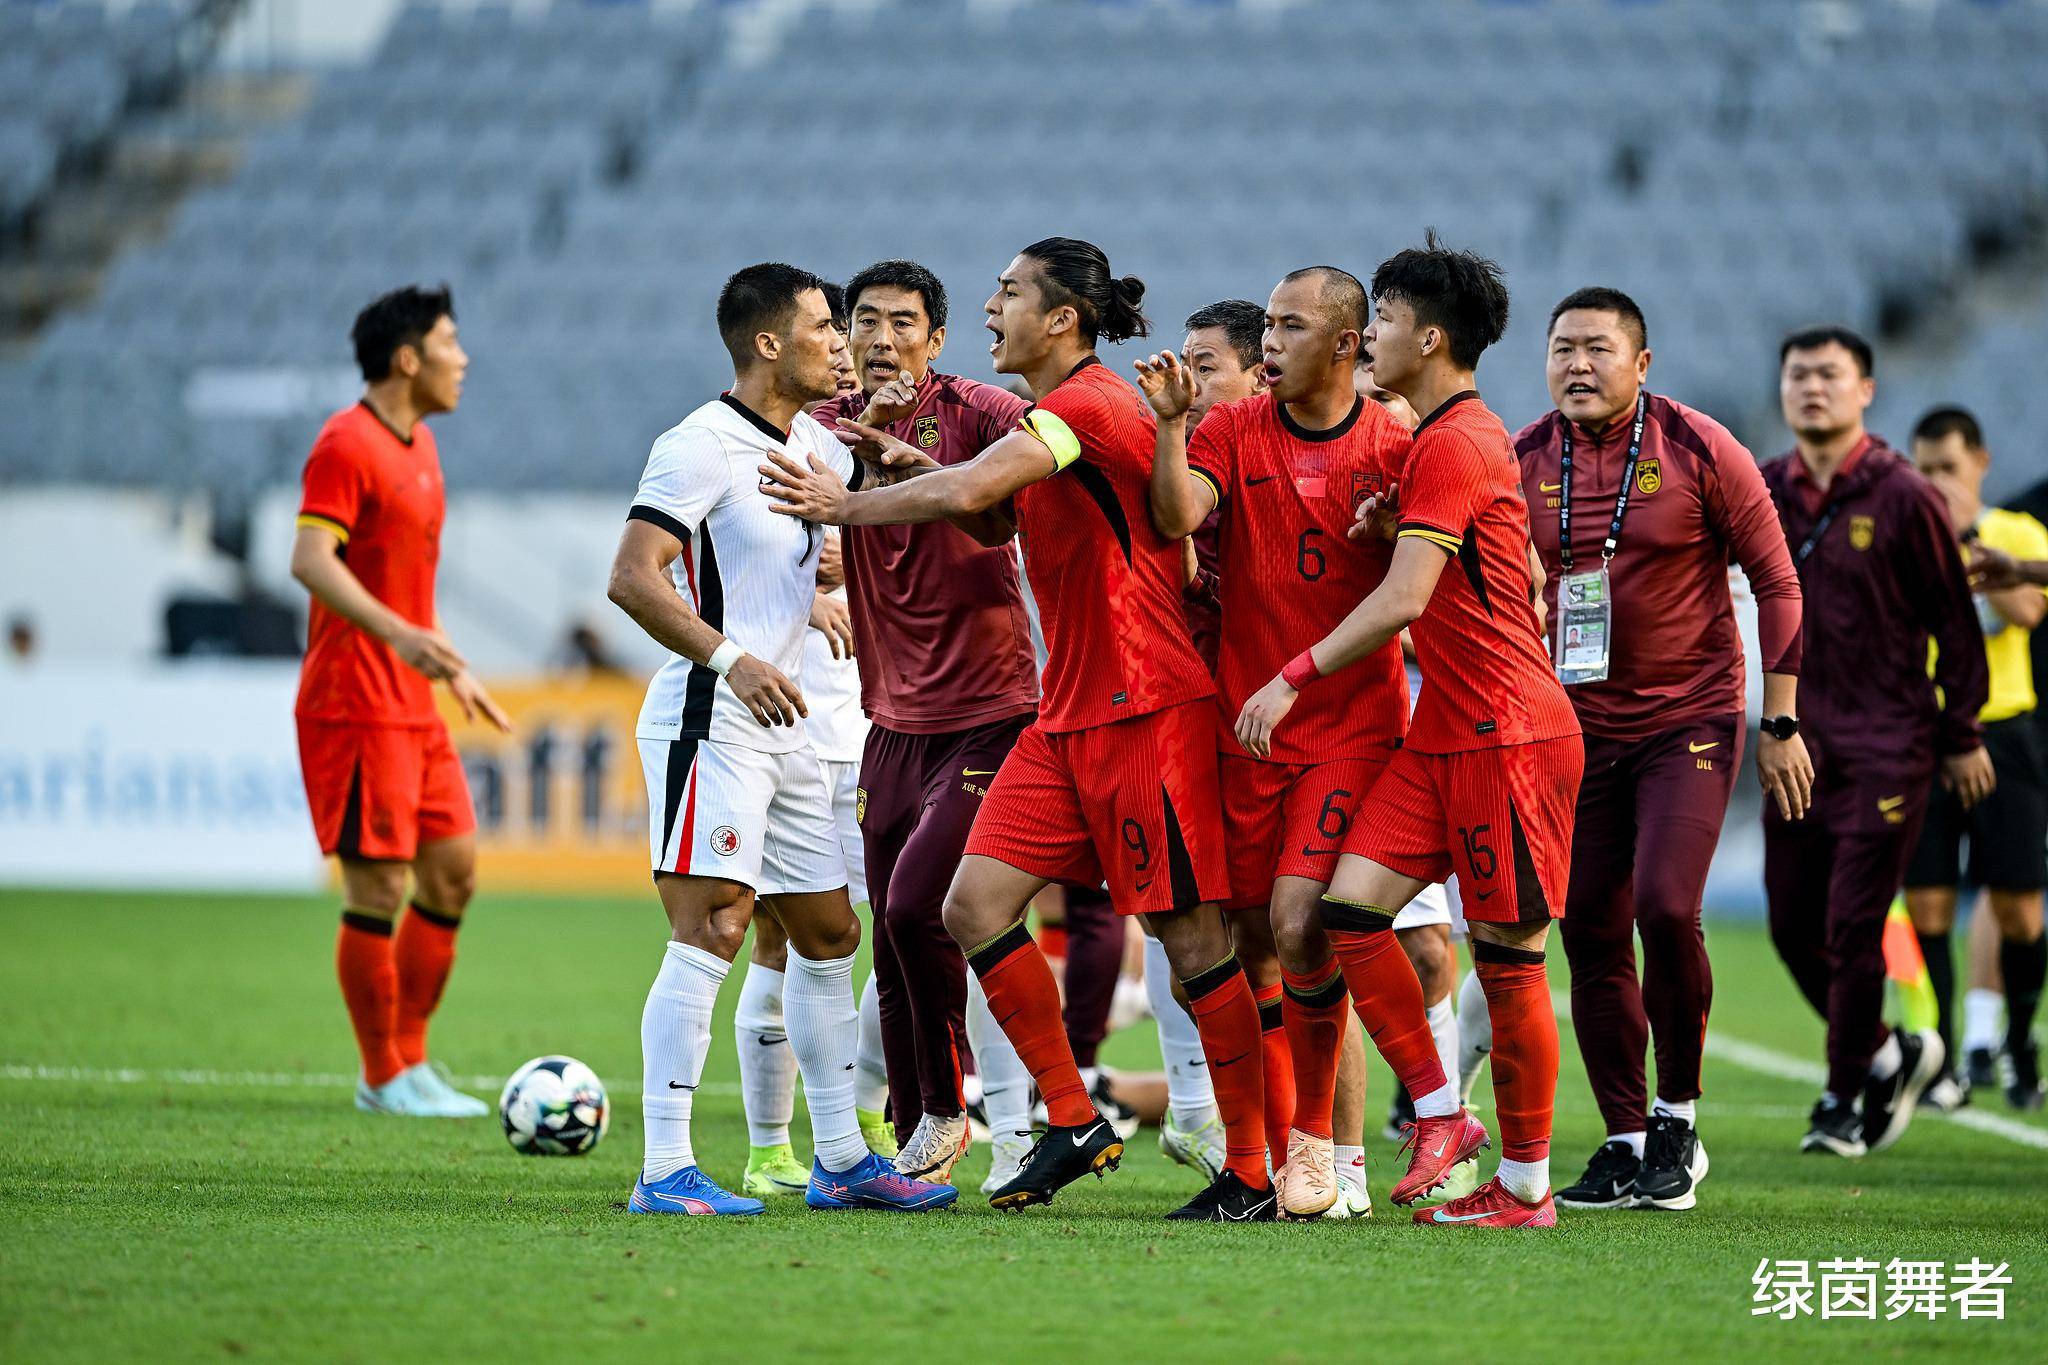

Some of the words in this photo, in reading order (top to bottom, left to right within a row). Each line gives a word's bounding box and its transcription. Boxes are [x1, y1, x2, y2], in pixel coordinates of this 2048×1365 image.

[1298, 528, 1326, 582] 6
[961, 782, 977, 794] XUE
[1317, 789, 1352, 839] 6
[1122, 818, 1150, 871] 9
[1458, 824, 1496, 880] 15
